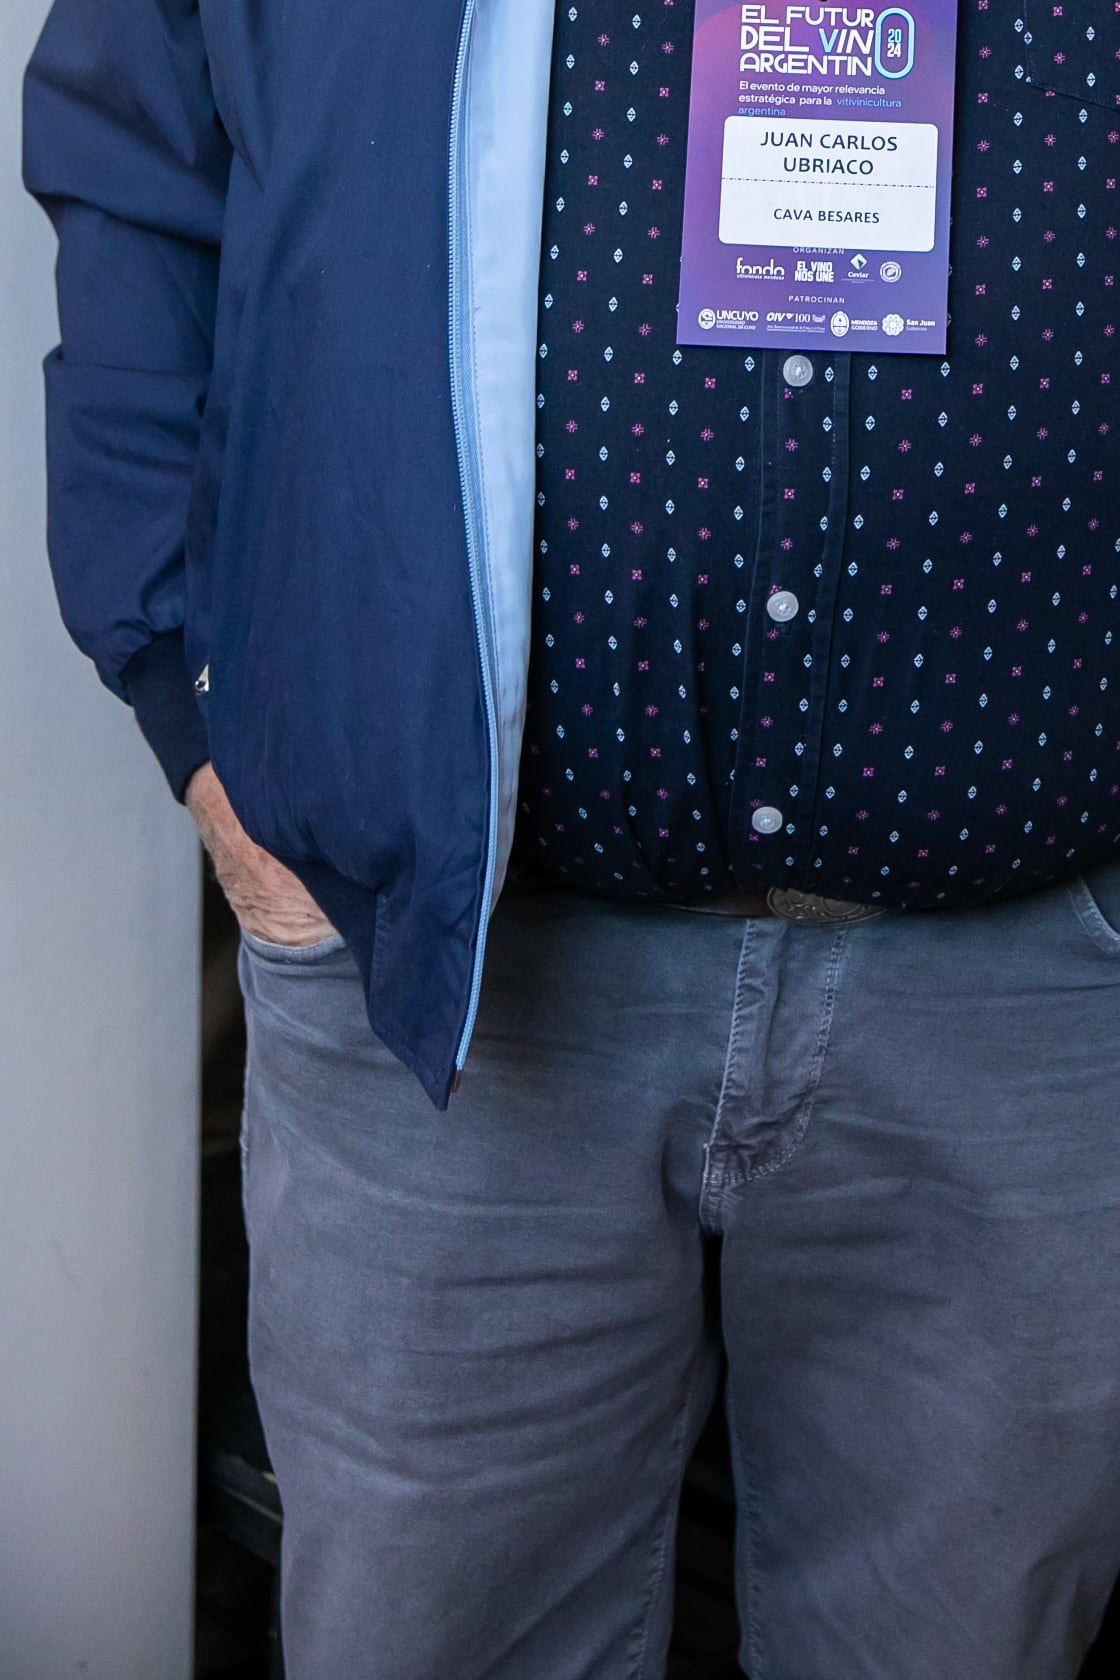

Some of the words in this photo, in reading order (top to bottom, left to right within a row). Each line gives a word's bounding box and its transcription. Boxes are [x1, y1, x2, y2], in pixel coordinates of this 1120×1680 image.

[741, 4, 779, 24] EL
[741, 27, 809, 52] DEL
[739, 81, 748, 90] El
[750, 82, 785, 92] evento
[787, 83, 800, 92] de
[802, 85, 833, 95] mayor
[835, 85, 885, 95] relevancia
[739, 93, 795, 105] estratégica
[800, 97, 821, 106] para
[823, 97, 832, 106] la
[837, 98, 902, 108] vitivinicultura
[738, 107, 786, 116] argentina
[760, 132, 813, 148] JUAN
[820, 134, 897, 151] CARLOS
[784, 157, 873, 175] UBRIACO
[774, 208, 813, 221] CAVA
[818, 211, 880, 223] BESARES
[793, 247, 845, 255] ORGANIZAN
[736, 257, 785, 275] fondo
[797, 261, 807, 271] EL
[811, 261, 833, 272] VINO
[795, 271, 815, 282] NOS
[816, 272, 834, 283] UNE
[789, 296, 845, 304] PATROCINAN
[717, 310, 758, 321] UNCUYO
[766, 312, 785, 321] OIV
[795, 314, 810, 323] 100
